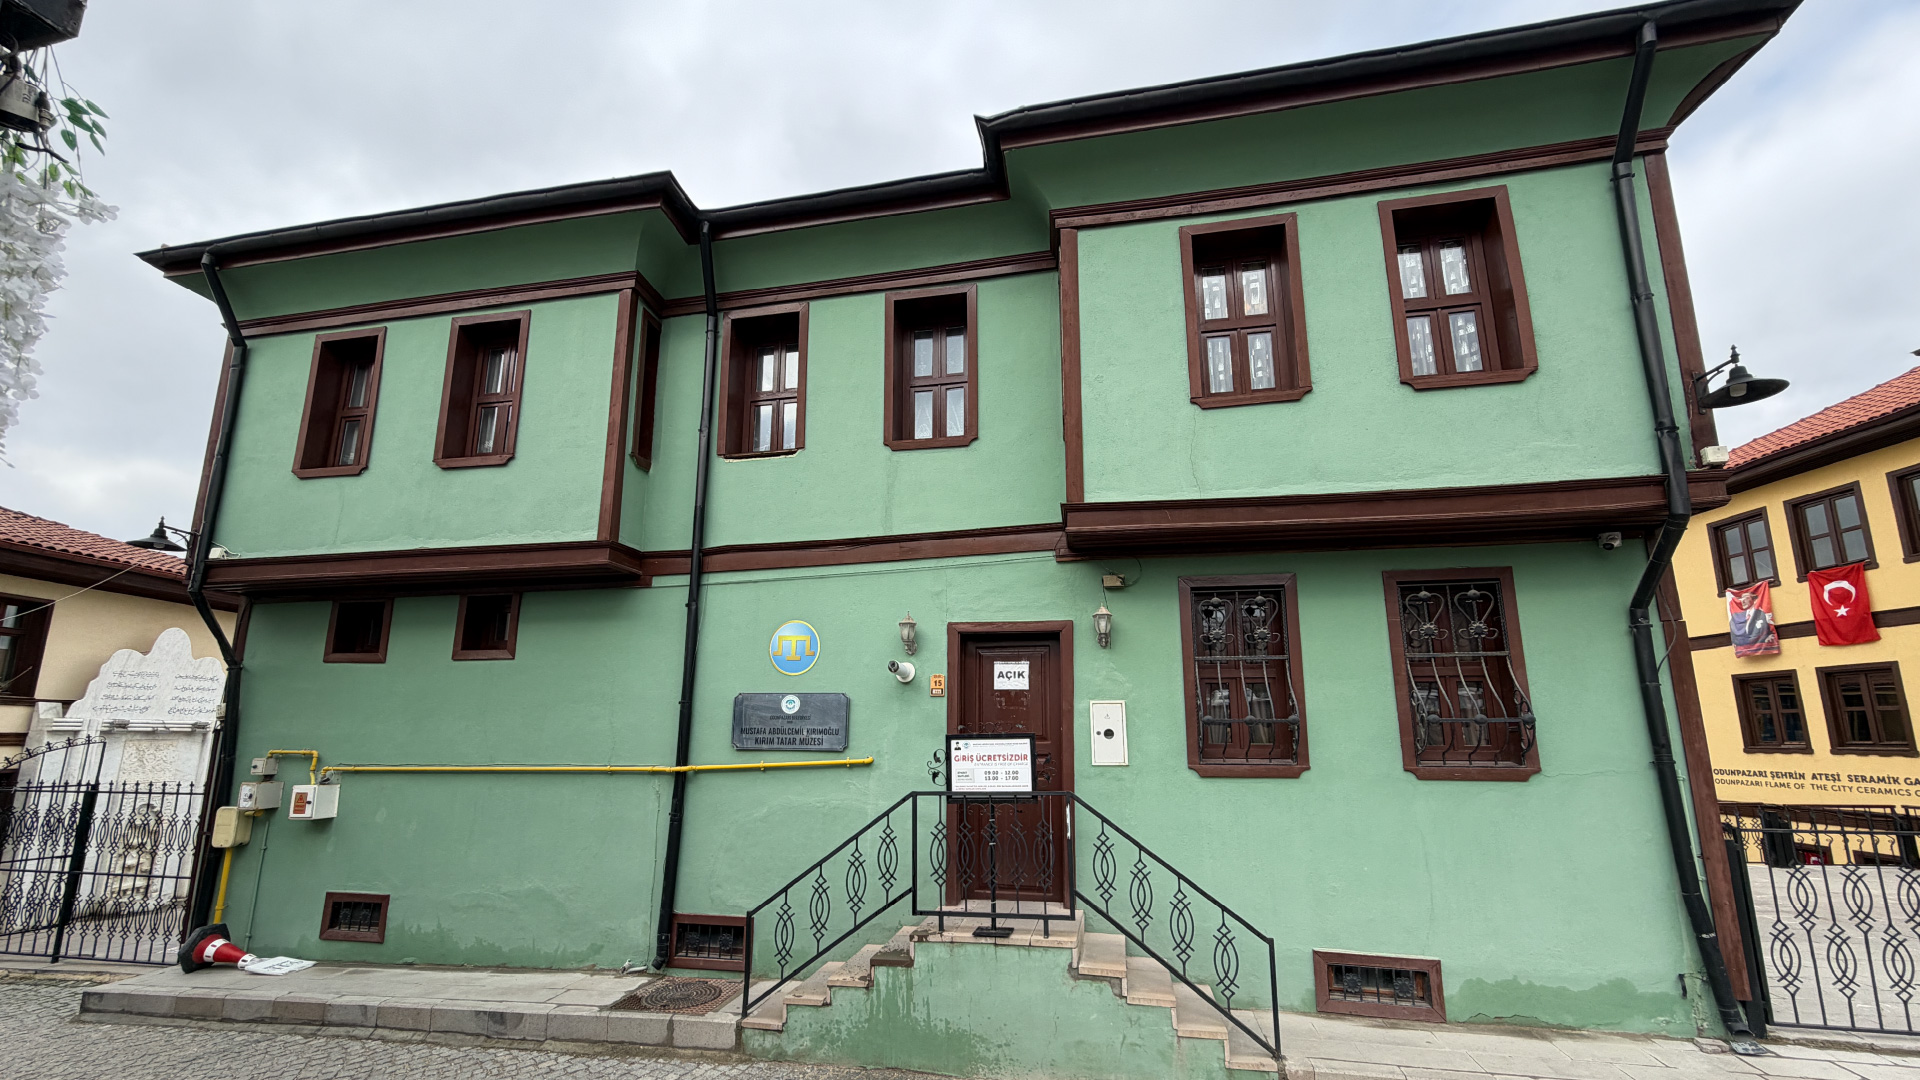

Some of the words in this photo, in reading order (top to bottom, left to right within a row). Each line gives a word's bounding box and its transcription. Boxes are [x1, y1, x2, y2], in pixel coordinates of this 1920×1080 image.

[997, 671, 1026, 680] AÇIK
[741, 727, 766, 735] MUSTAFA
[769, 726, 805, 735] ABDÜLCEMİL
[807, 726, 840, 736] KIRIMOĞLU
[755, 737, 774, 745] KIRIM
[777, 737, 797, 745] TATAR
[799, 735, 824, 745] MÜZESİ
[954, 753, 974, 763] GİRİŞ
[976, 752, 1029, 762] ÜCRETSİZDİR
[1713, 768, 1768, 778] ODUNPAZARI
[1770, 770, 1806, 780] ŞEHRİN
[1811, 772, 1841, 783] ATEŞİ
[1847, 774, 1901, 785] SERAMİK
[1714, 778, 1763, 787] ODUNPAZARI
[1765, 781, 1791, 789] FLAME
[1810, 783, 1828, 791] THE
[1857, 786, 1912, 796] CERAMICS
